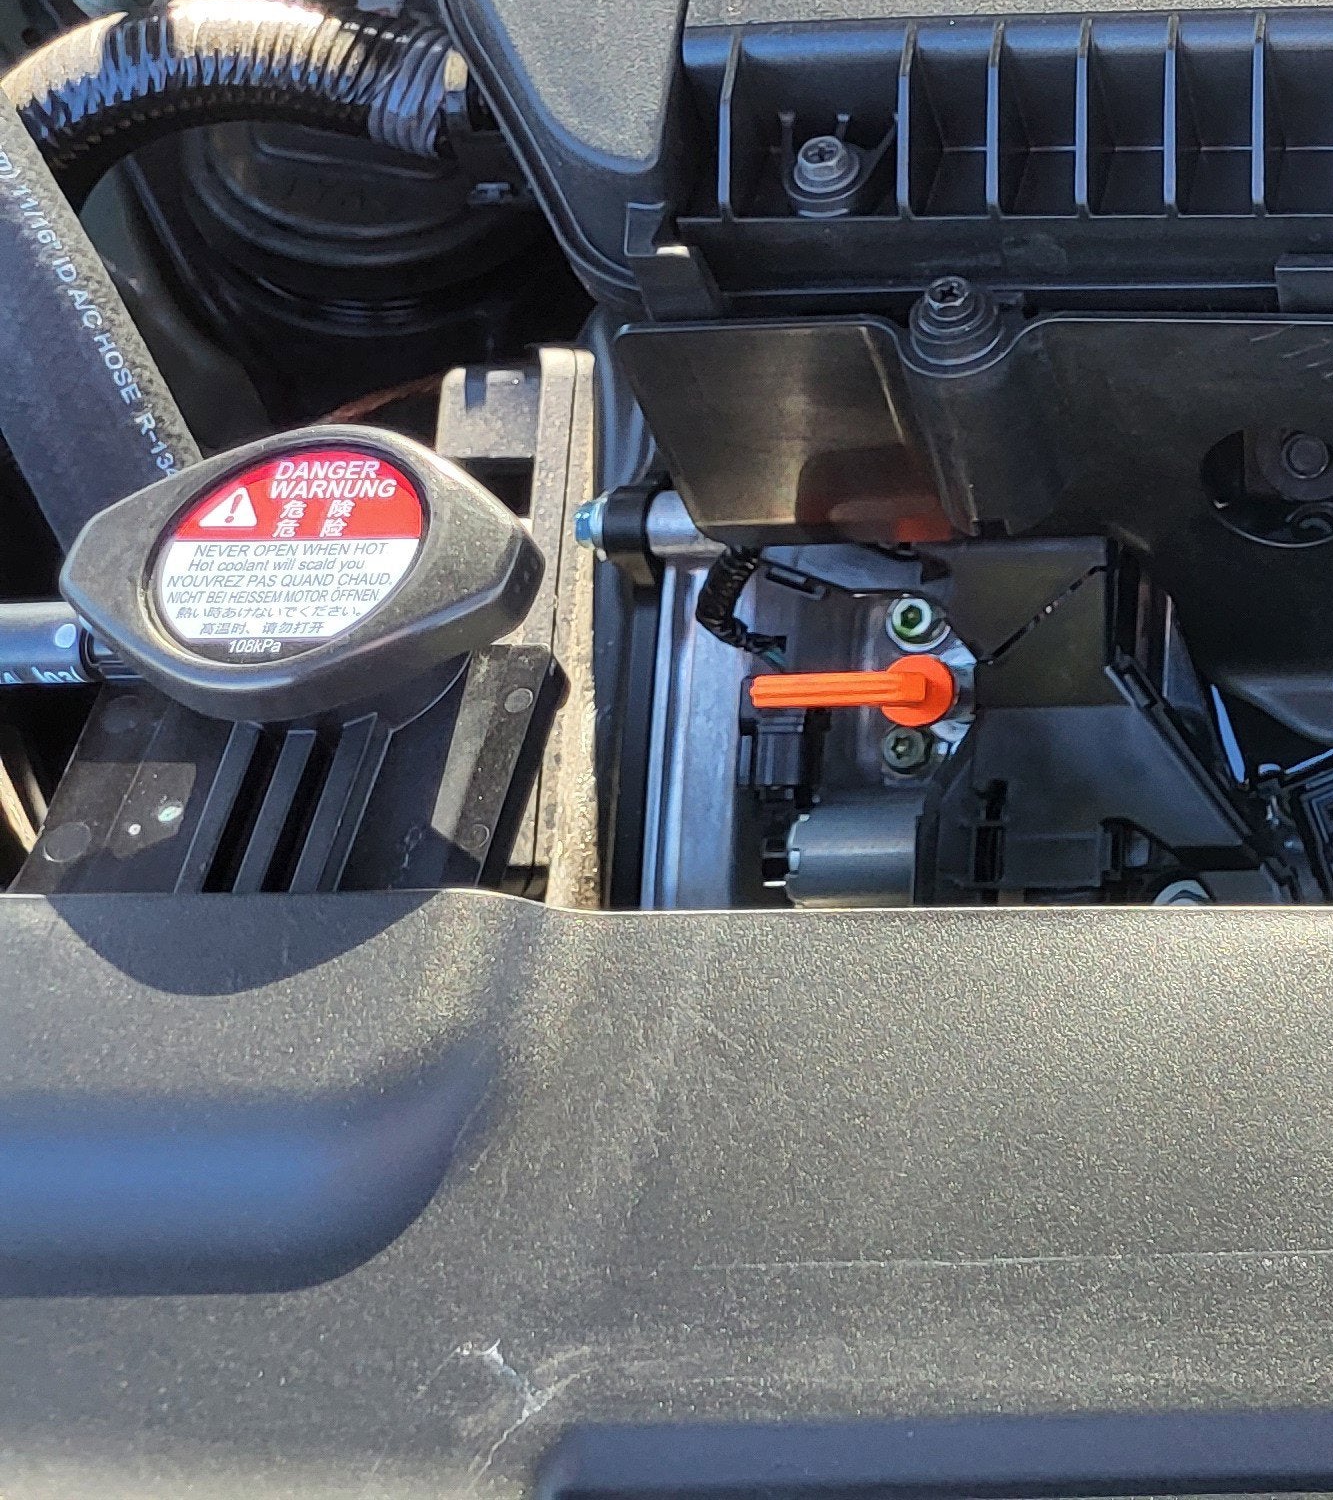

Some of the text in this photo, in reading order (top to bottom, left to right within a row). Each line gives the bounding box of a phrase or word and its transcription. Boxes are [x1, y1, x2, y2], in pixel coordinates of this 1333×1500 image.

[52, 256, 77, 283] ID
[67, 288, 103, 329] A/C
[93, 332, 142, 405] HOSE
[275, 460, 380, 480] DANGER
[270, 479, 398, 499] WARNUNG
[193, 544, 250, 558] NEVER
[253, 543, 299, 557] OPEN
[302, 543, 352, 556] WHEN
[187, 559, 214, 572] Hot
[216, 559, 269, 572] coolant
[272, 558, 296, 571] will
[297, 558, 337, 571] scald
[166, 572, 393, 588] N'OUVREZ PAS QUAND CHAUD.
[166, 590, 206, 604] NICHT
[205, 590, 228, 604] BEI
[228, 590, 283, 604] HEISSEM
[283, 589, 329, 603] MOTOR
[228, 638, 283, 654] 108kPa
